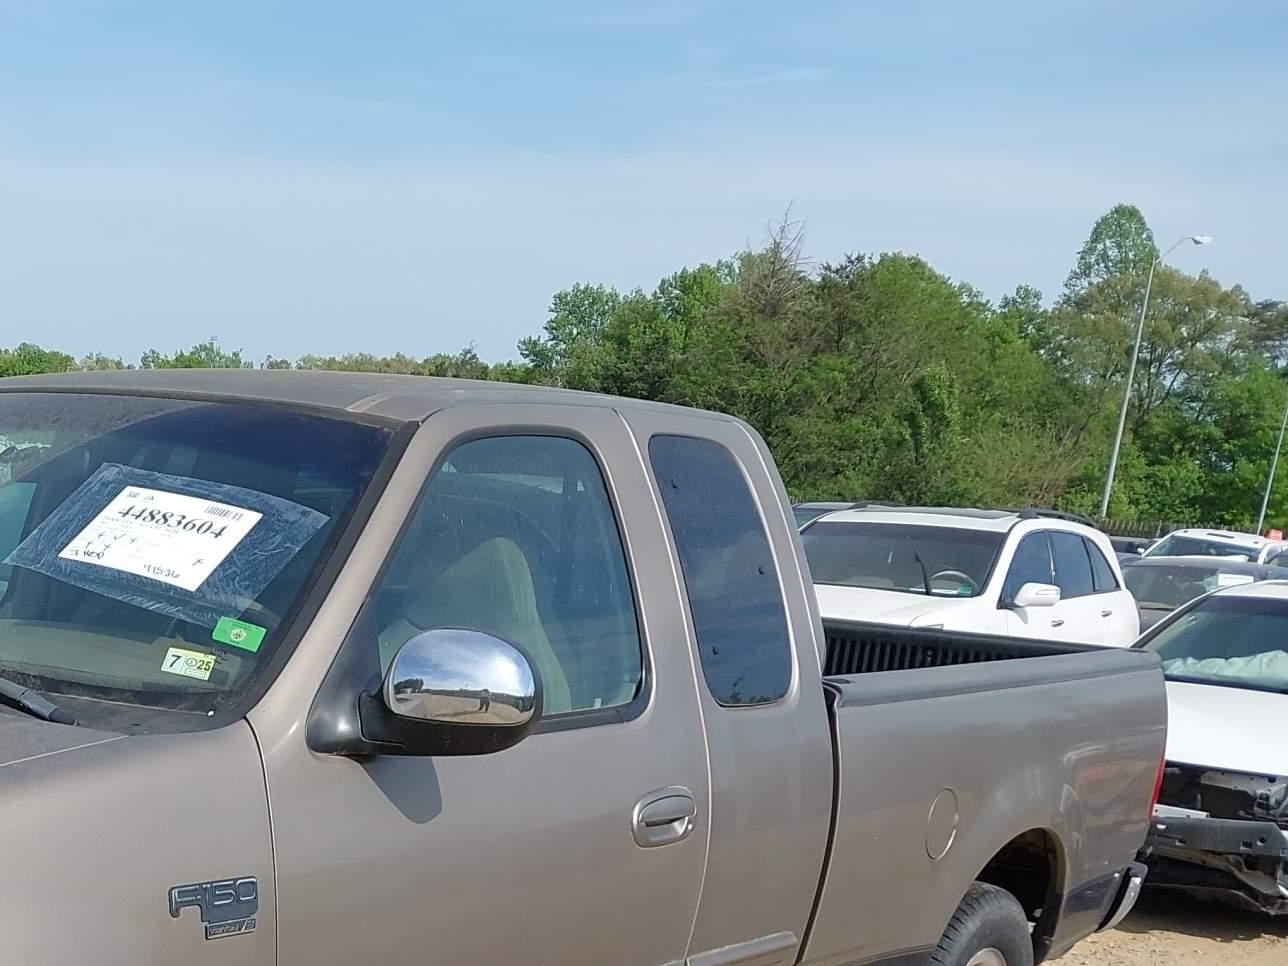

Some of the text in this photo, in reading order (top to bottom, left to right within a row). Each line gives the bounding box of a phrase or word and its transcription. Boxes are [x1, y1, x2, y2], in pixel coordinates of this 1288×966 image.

[117, 504, 229, 539] 44883604
[168, 654, 213, 672] 7 25
